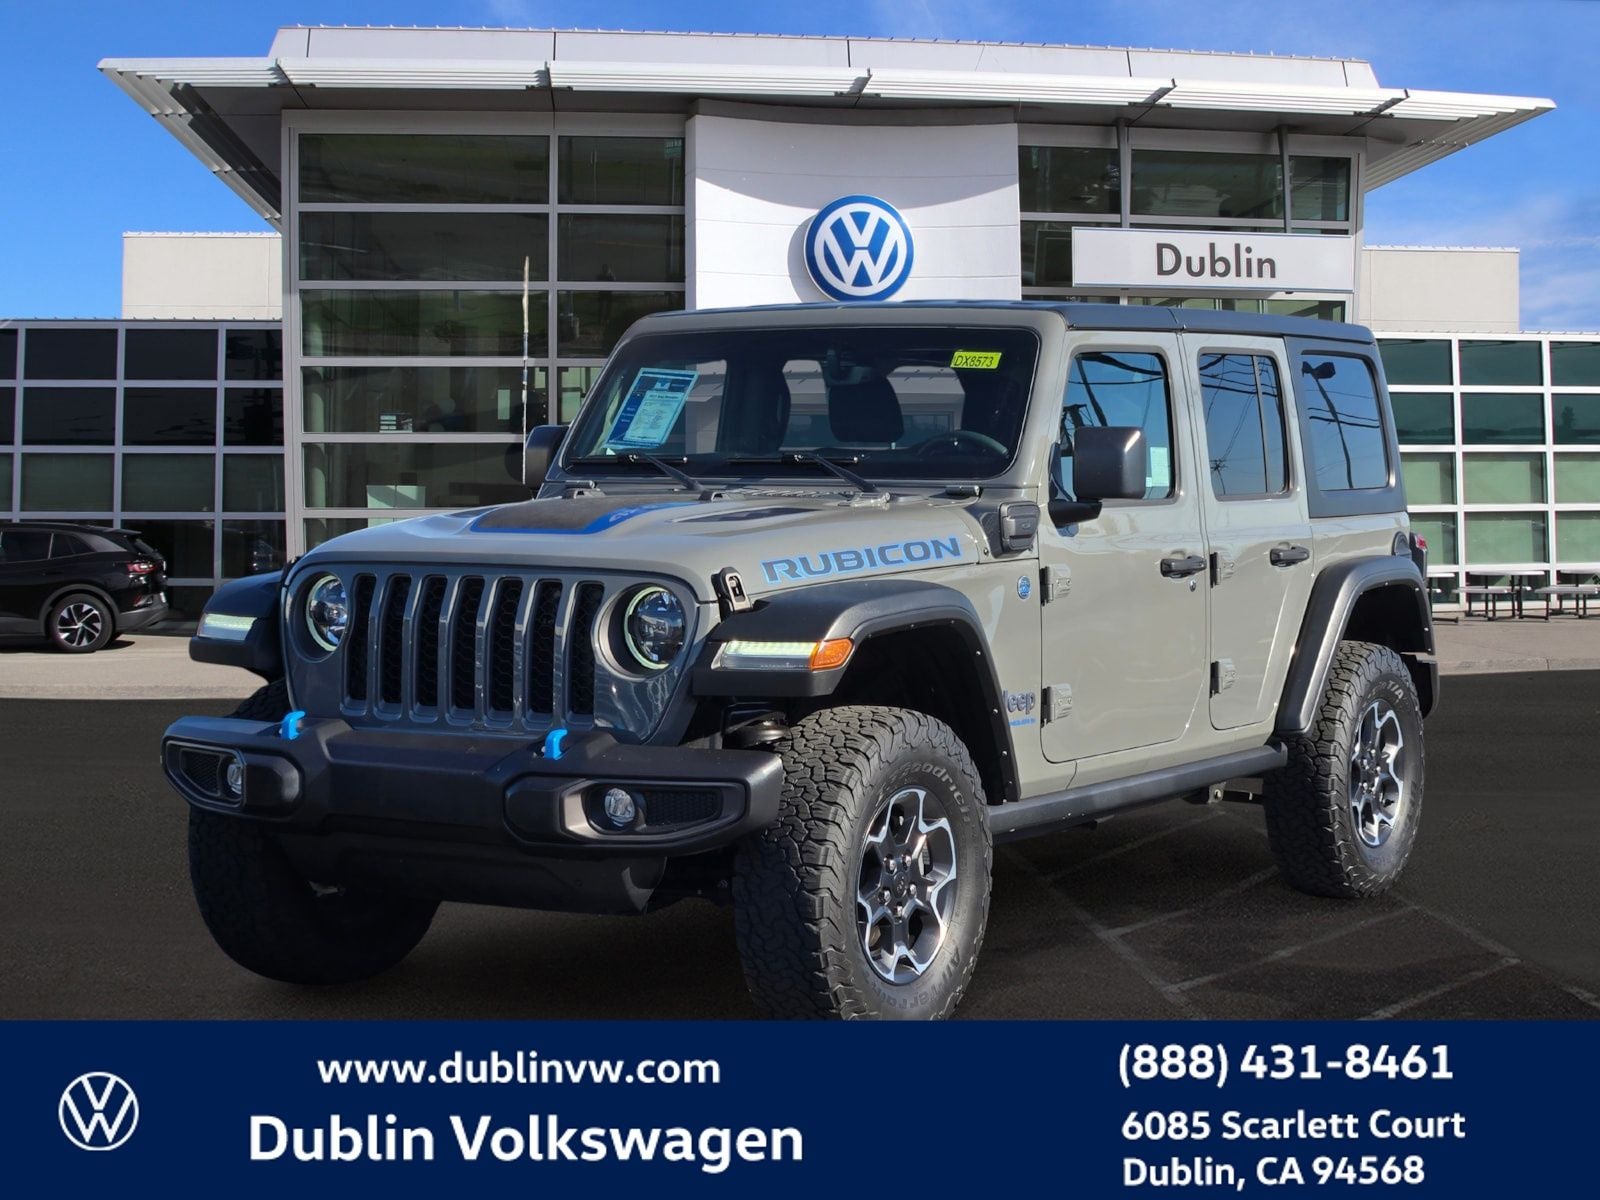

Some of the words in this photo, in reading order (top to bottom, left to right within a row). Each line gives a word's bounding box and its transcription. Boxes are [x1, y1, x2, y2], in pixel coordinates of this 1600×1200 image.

[814, 203, 907, 296] VW
[1156, 242, 1276, 279] Dublin
[954, 355, 994, 368] DX8573
[762, 537, 961, 582] RUBICON
[1002, 690, 1036, 715] Jeep
